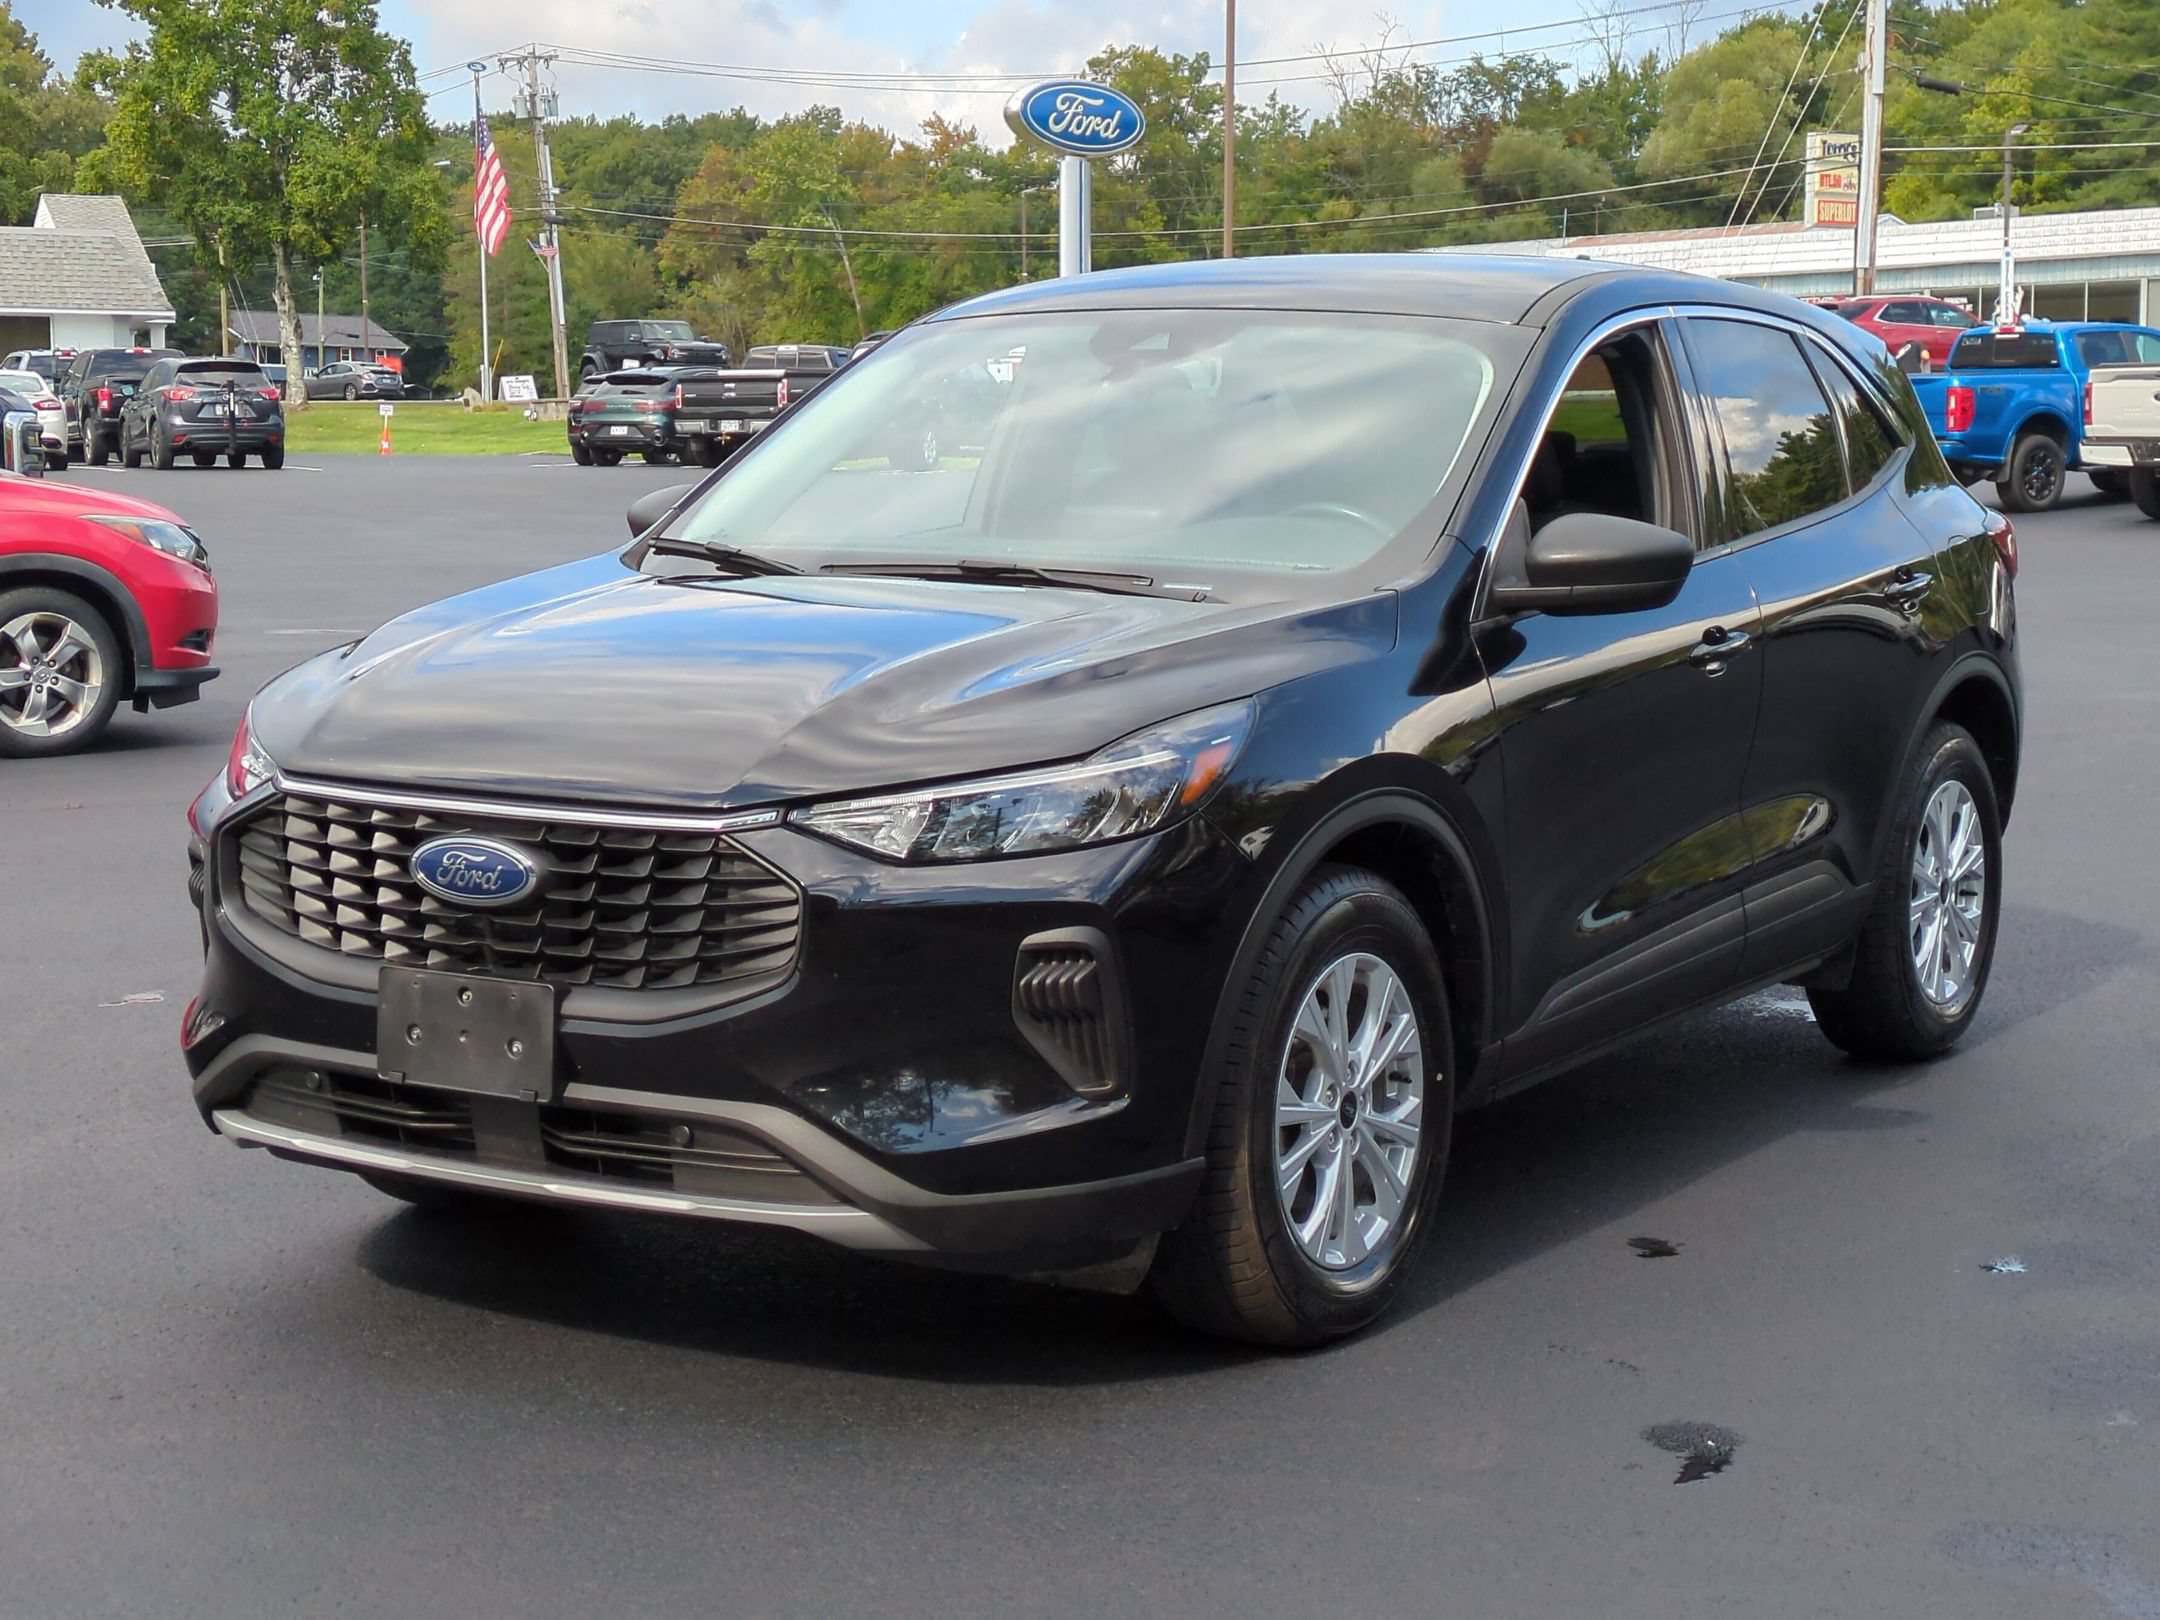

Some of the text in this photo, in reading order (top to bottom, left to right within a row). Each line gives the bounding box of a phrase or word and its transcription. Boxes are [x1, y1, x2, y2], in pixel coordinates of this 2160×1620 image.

[1049, 93, 1122, 138] Ford
[1819, 202, 1857, 222] SUPERLOT
[436, 850, 502, 890] Ford
